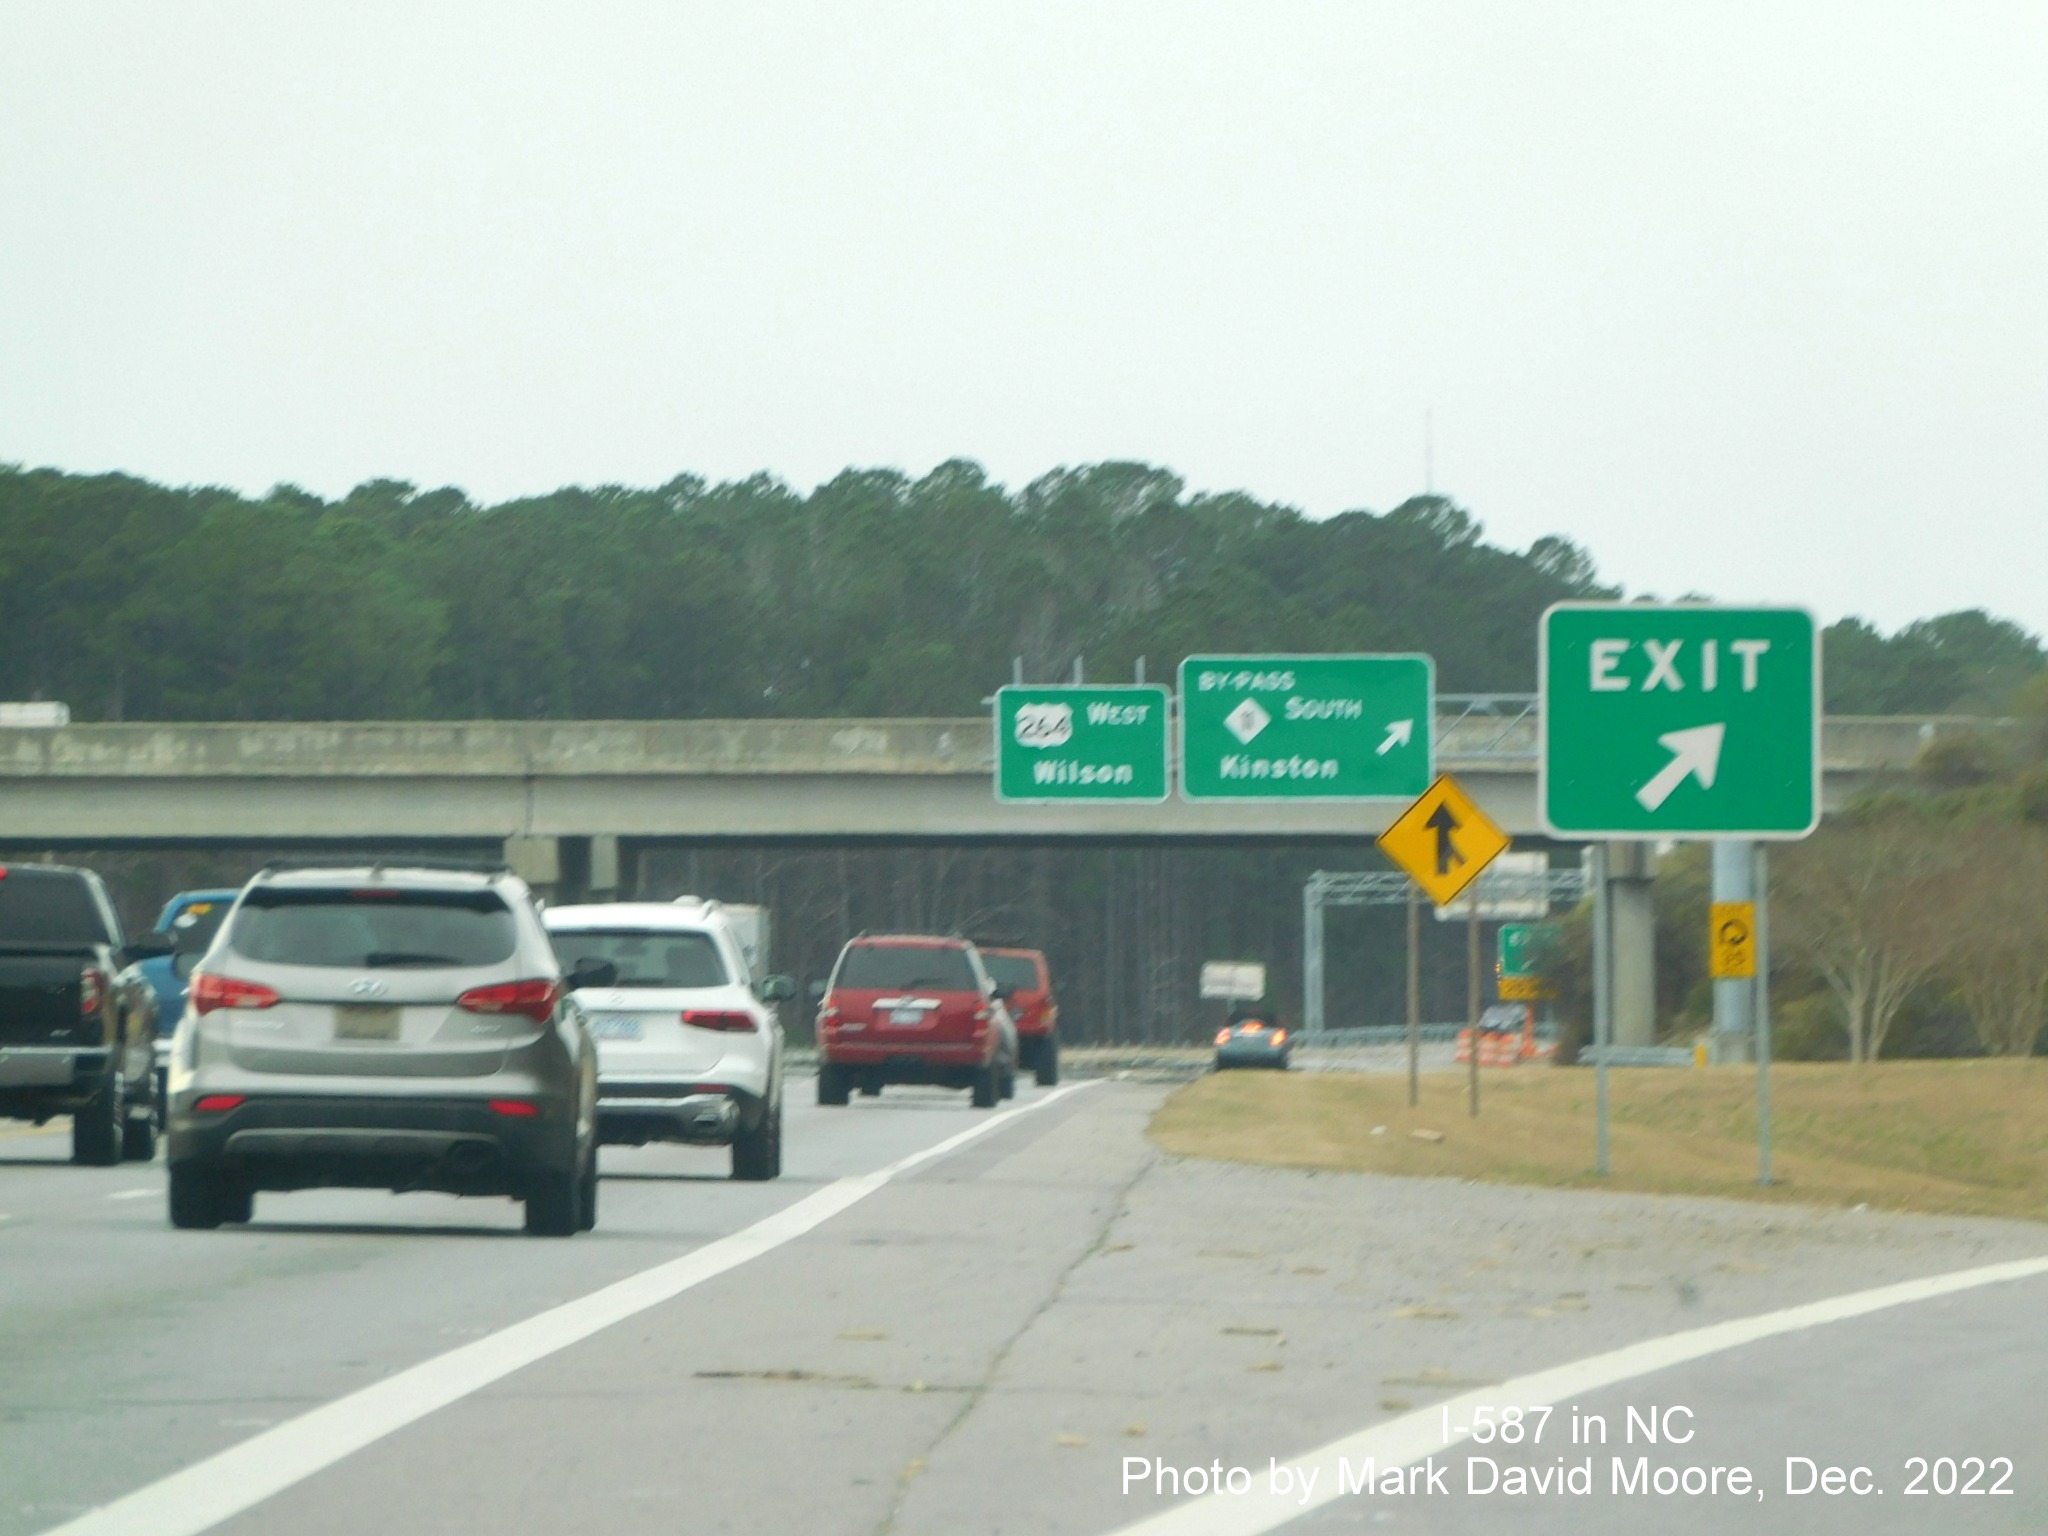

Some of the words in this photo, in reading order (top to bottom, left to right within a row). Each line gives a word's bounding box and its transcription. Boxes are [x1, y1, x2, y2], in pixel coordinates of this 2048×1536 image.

[1589, 638, 1771, 692] EXIT
[1285, 696, 1362, 719] SOUTH
[1034, 760, 1133, 784] Wilson
[1220, 754, 1339, 779] Kinston
